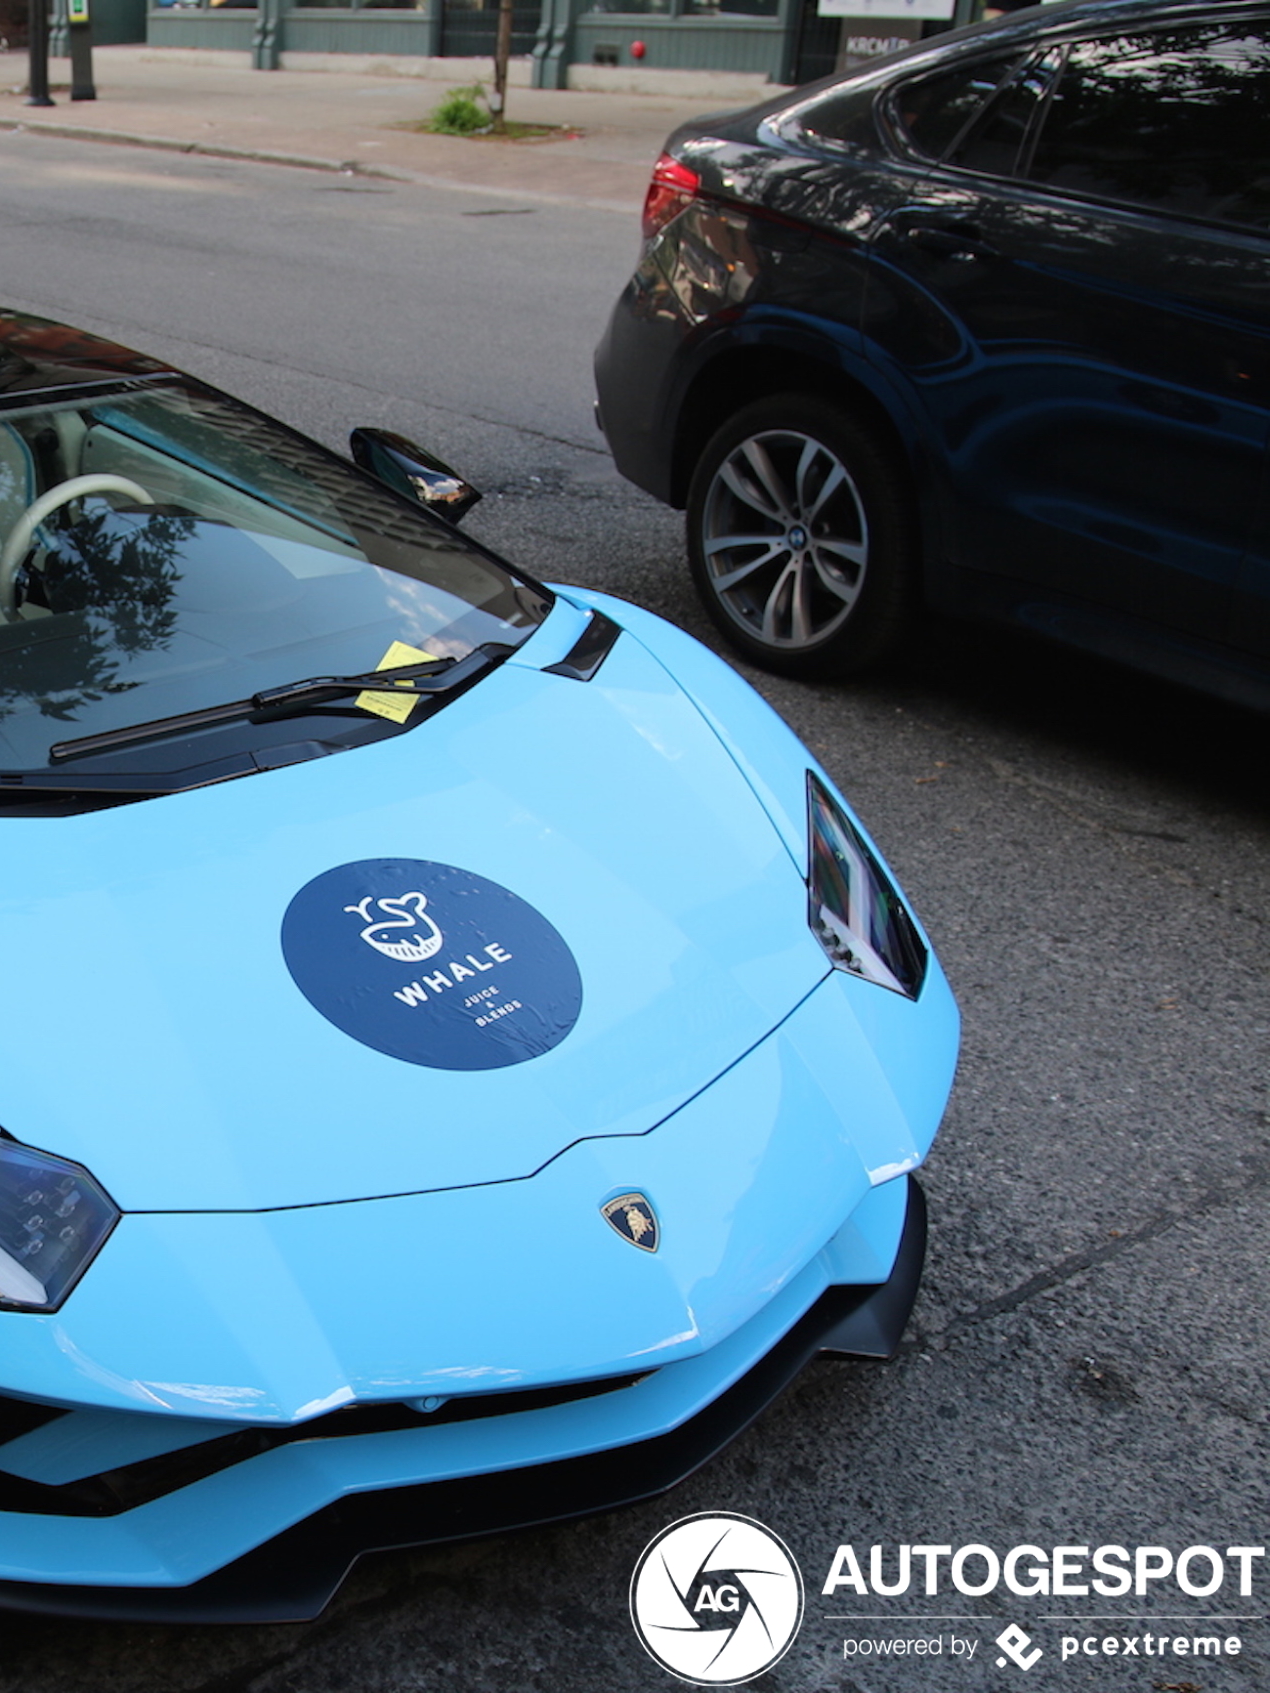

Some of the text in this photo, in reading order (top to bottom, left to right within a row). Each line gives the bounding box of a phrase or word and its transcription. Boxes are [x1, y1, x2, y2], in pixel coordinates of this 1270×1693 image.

[393, 943, 512, 1007] WHALE
[464, 985, 499, 1008] JUICE
[475, 1000, 523, 1027] BLENDS
